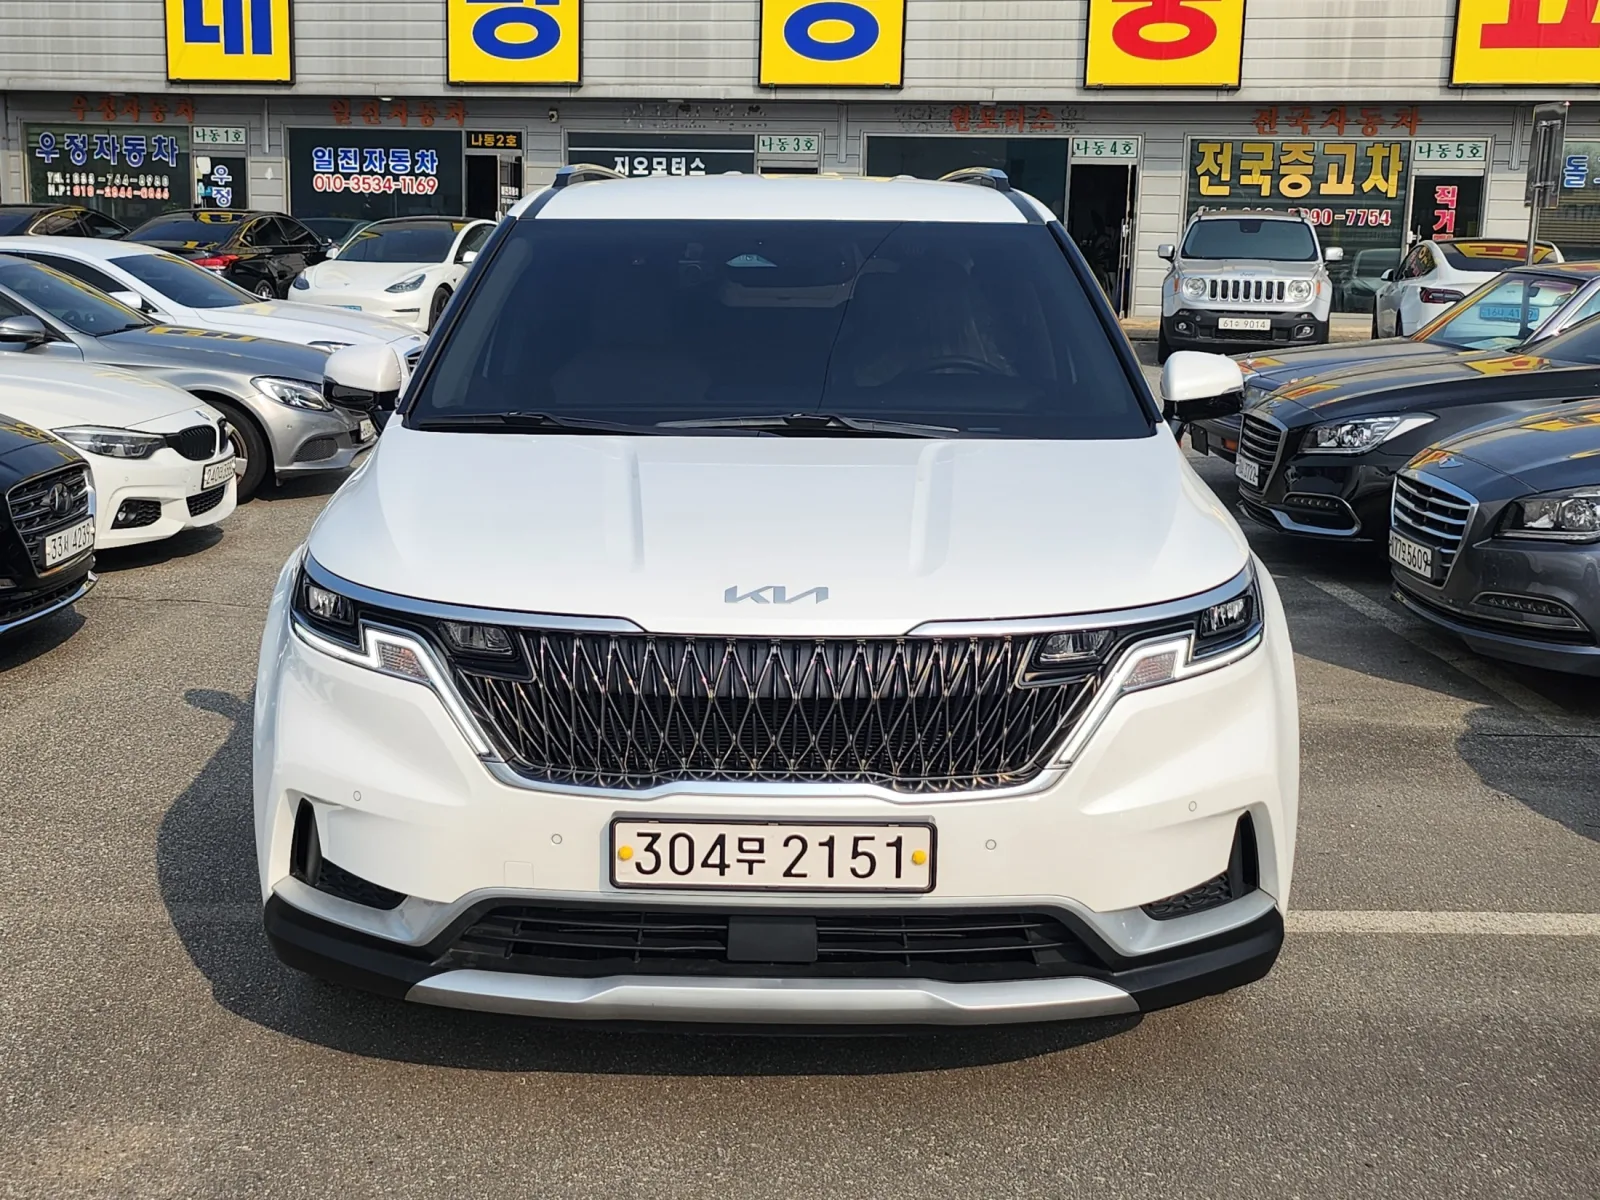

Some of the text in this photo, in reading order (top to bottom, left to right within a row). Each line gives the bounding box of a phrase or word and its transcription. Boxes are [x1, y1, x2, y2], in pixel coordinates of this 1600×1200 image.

[35, 131, 179, 168] 우정자동차
[471, 133, 517, 148] 나동2호
[312, 147, 438, 174] 일진자동차
[613, 156, 706, 177] 지오모터스
[1195, 141, 1404, 199] 전국중고차
[313, 173, 439, 195] 010-3534-1169
[724, 585, 829, 604] KIA
[634, 832, 903, 879] 304무 2151
